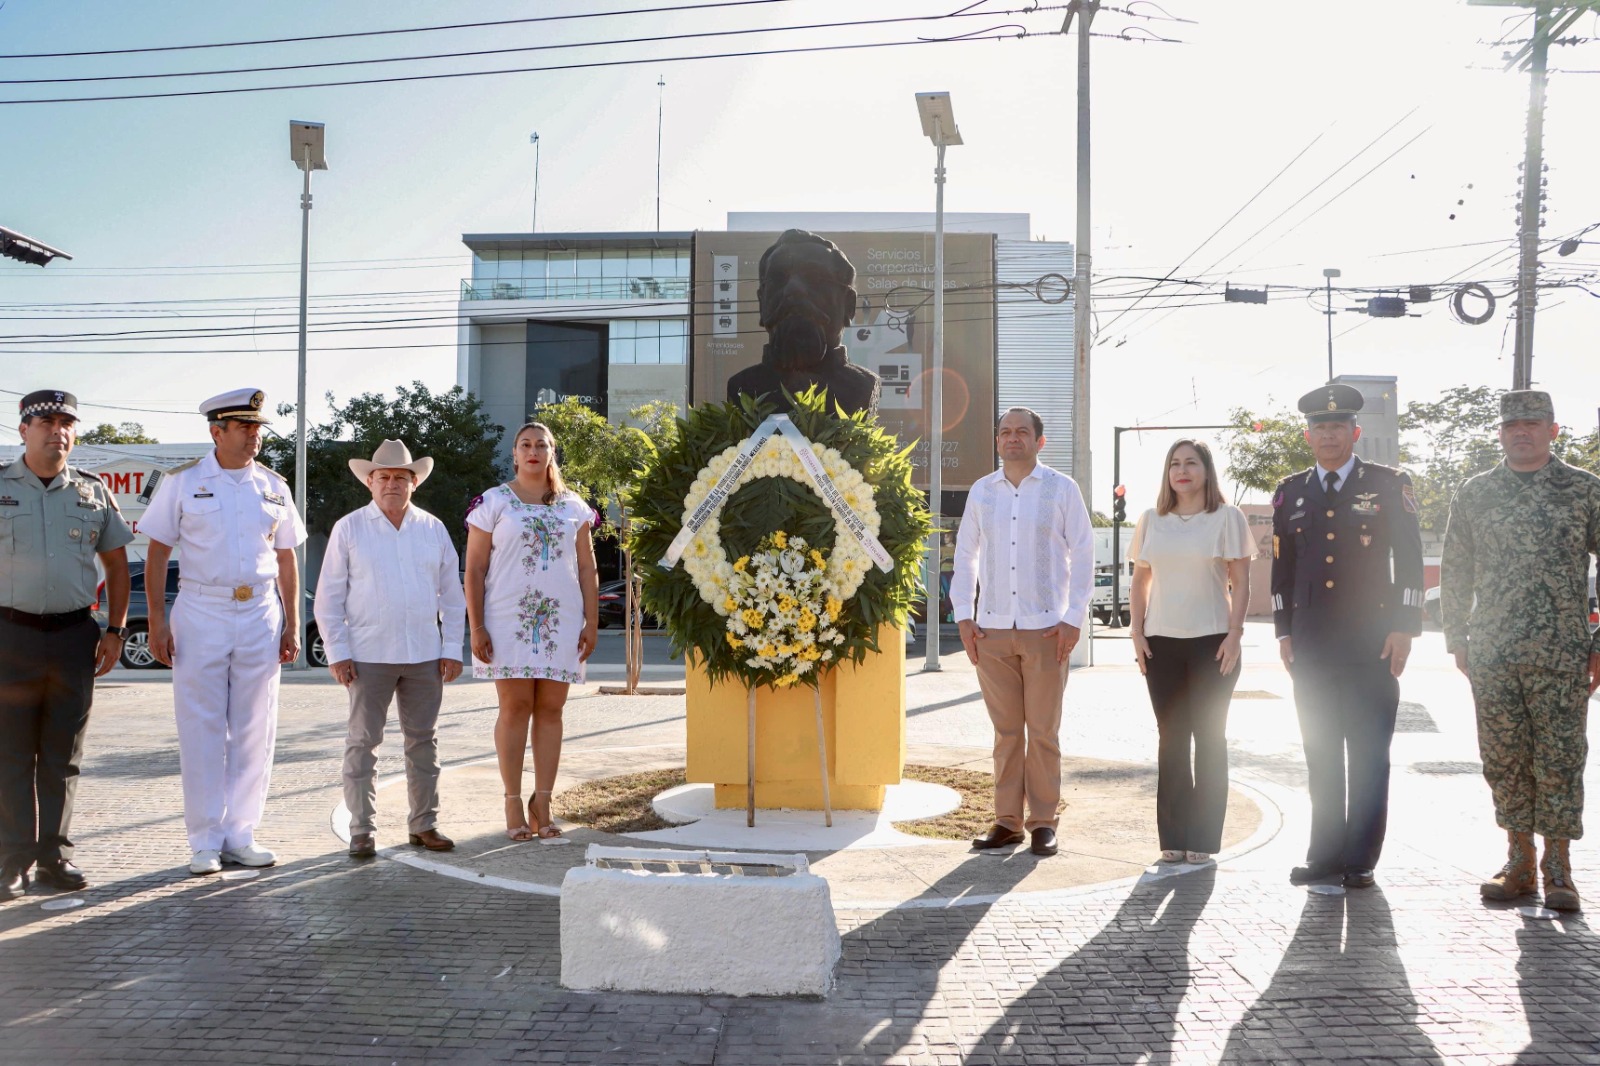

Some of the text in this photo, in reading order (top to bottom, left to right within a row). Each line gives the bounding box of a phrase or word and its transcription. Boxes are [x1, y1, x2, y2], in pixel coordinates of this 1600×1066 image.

[867, 248, 920, 260] Servicios
[867, 262, 936, 275] corporativo
[867, 277, 898, 289] Salas
[901, 277, 918, 289] de
[750, 436, 767, 457] MEXICANOS
[941, 456, 959, 468] 478
[854, 530, 865, 541] 2025
